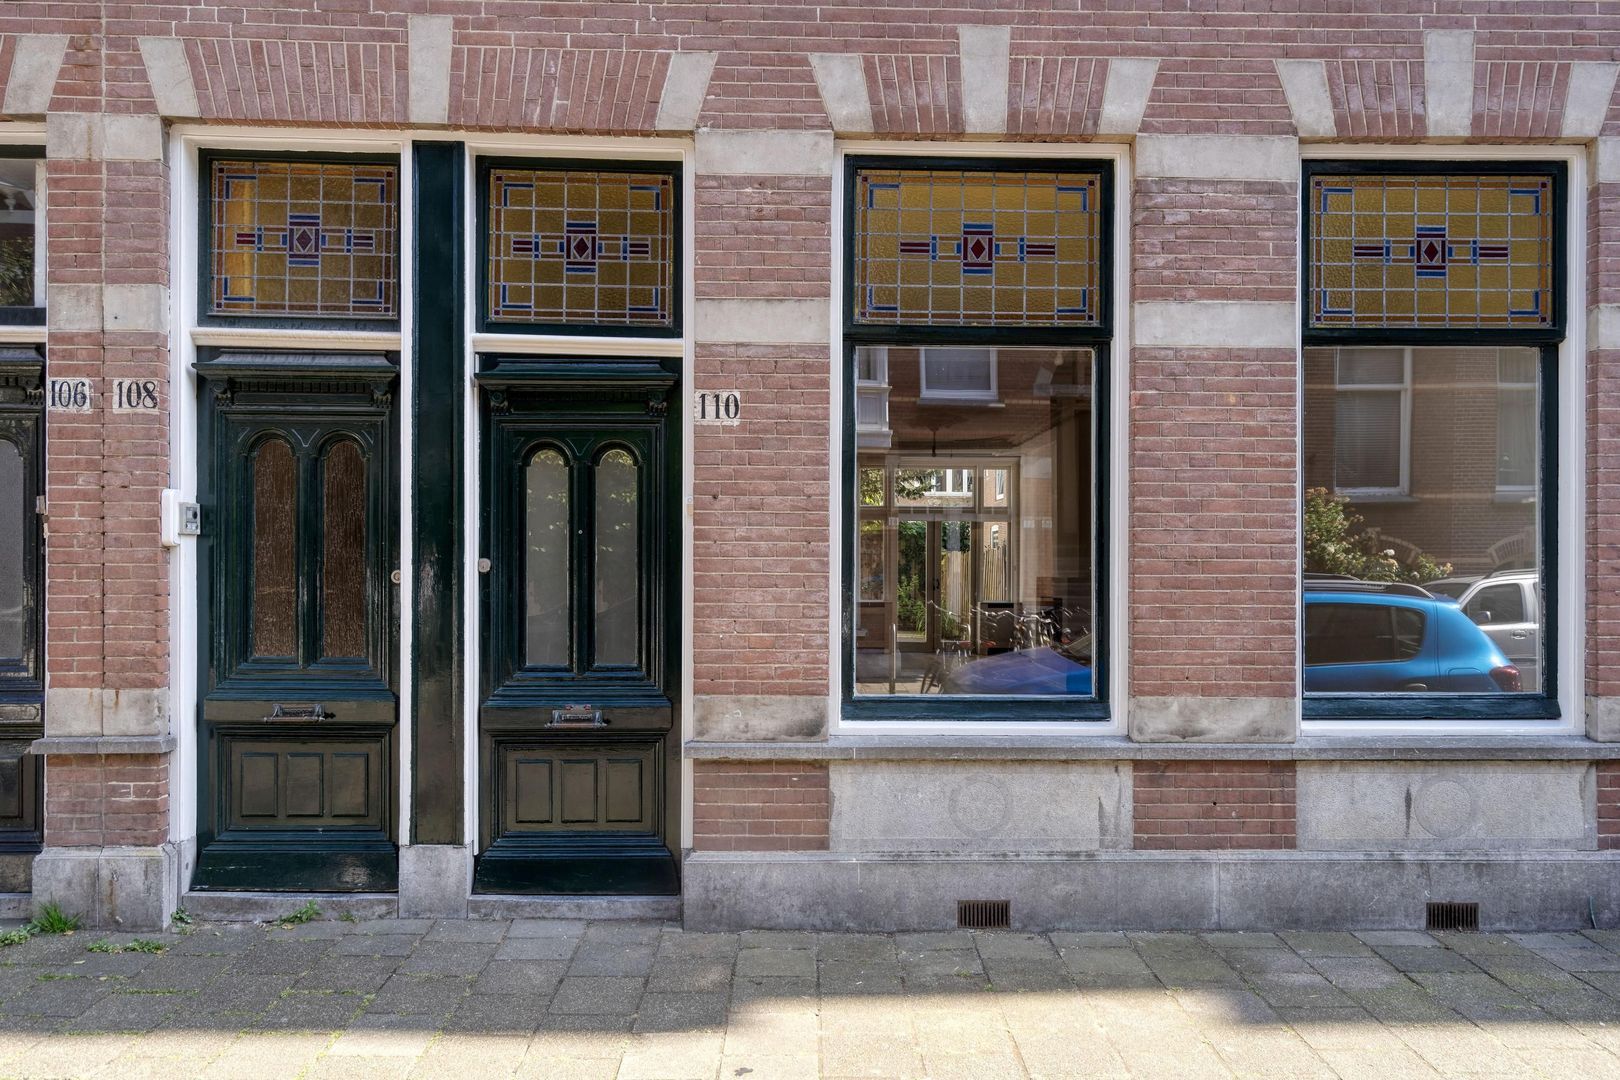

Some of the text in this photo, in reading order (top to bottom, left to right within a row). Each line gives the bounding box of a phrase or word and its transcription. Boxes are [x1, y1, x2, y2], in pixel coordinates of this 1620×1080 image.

[51, 380, 87, 408] 106
[117, 380, 158, 409] 108
[699, 393, 740, 420] 110
